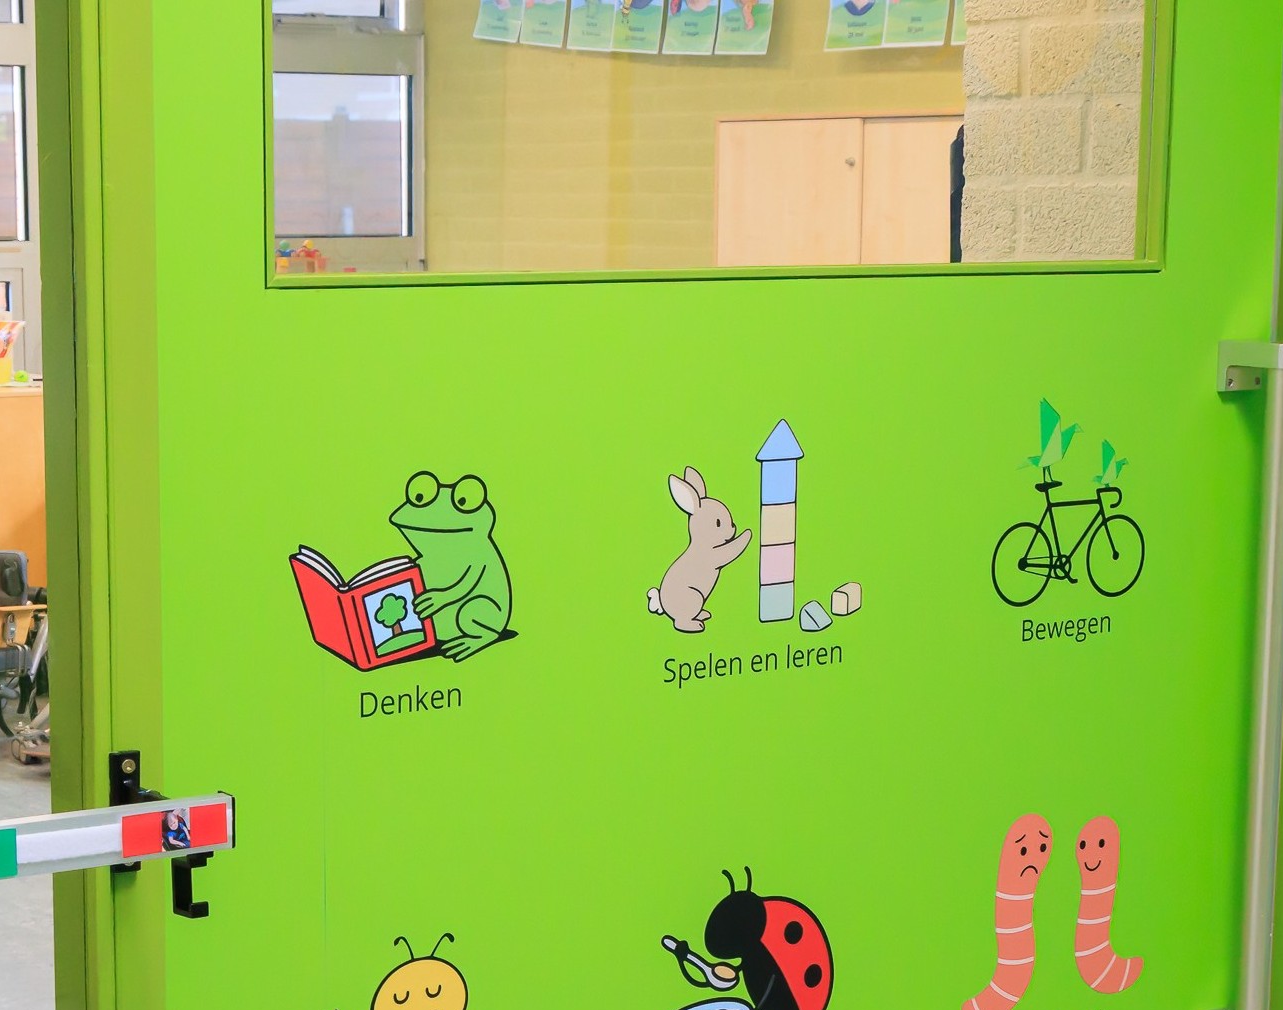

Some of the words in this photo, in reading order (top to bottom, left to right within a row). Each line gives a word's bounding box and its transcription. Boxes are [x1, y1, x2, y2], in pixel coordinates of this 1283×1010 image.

[1021, 615, 1111, 643] Bewegen
[663, 652, 742, 689] Spelen
[750, 652, 778, 673] en
[786, 644, 842, 669] leren
[360, 684, 462, 718] Denken
